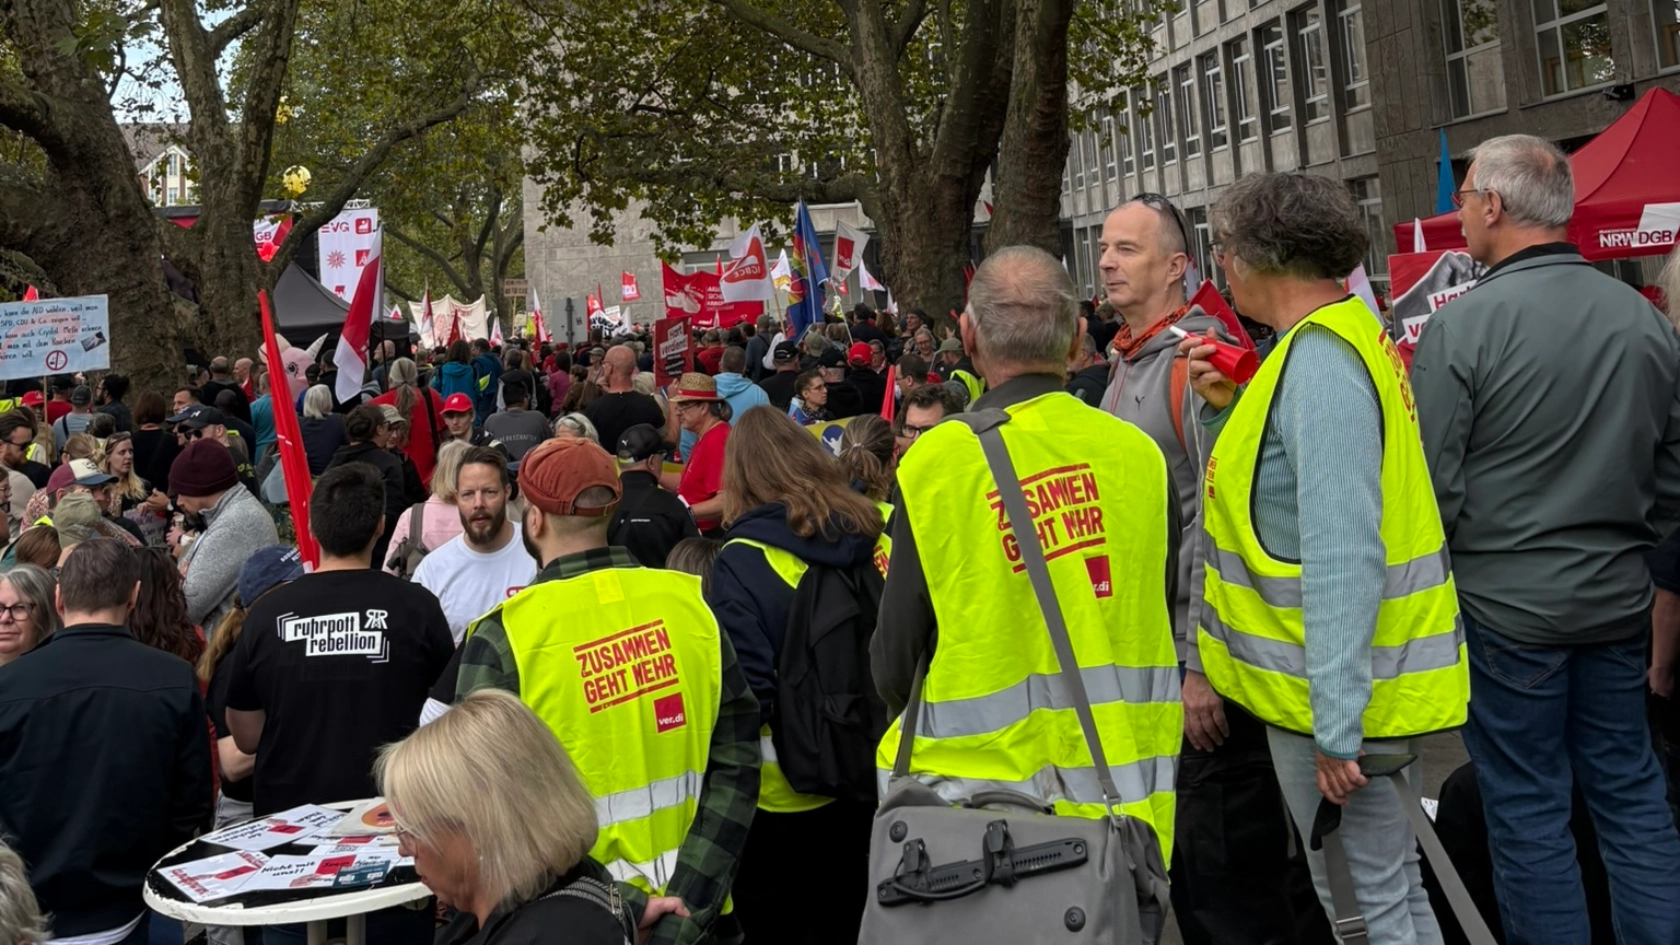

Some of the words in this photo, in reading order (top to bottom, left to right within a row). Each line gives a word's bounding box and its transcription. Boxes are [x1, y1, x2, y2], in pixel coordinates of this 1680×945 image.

[255, 231, 272, 241] GB
[1599, 231, 1637, 248] NRW
[1638, 230, 1673, 245] DGB
[294, 616, 355, 639] ruhrpott
[310, 633, 376, 653] rebellion
[584, 669, 628, 704] GEHT
[658, 713, 684, 726] ver.di
[261, 864, 293, 873] Nicht
